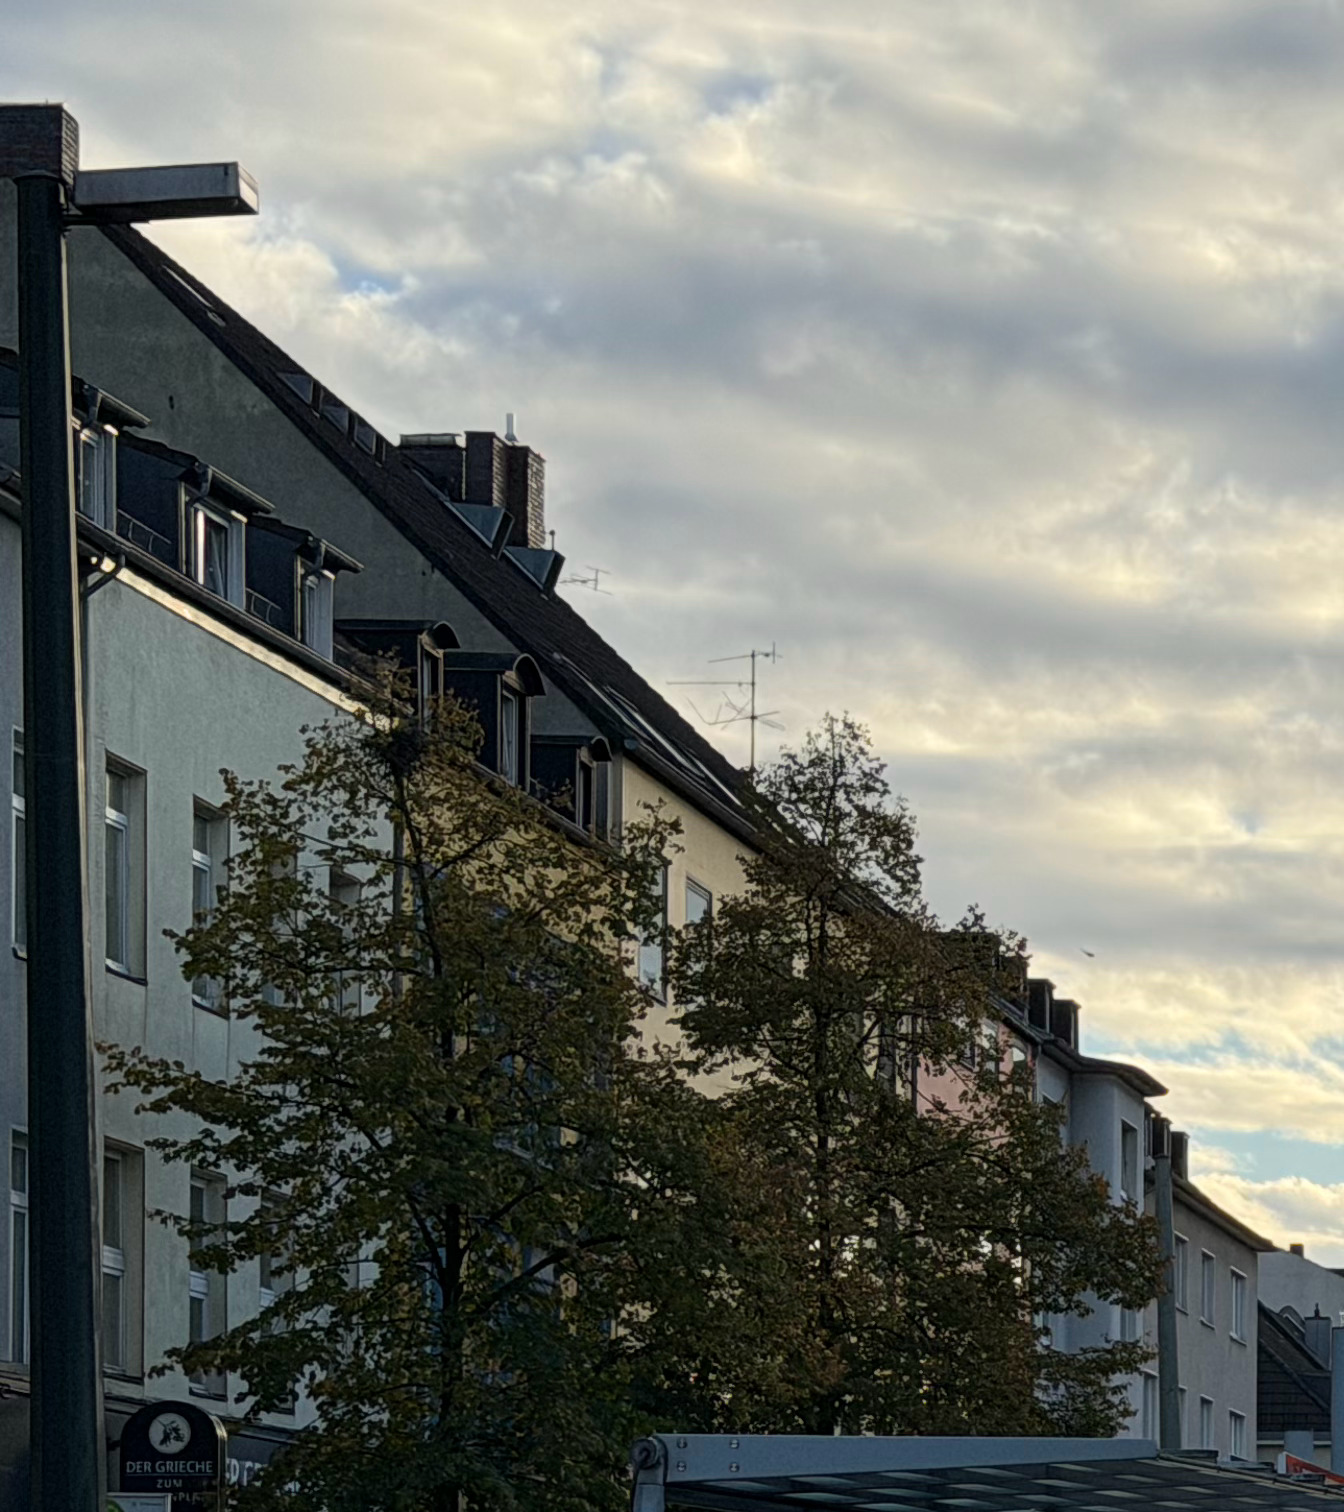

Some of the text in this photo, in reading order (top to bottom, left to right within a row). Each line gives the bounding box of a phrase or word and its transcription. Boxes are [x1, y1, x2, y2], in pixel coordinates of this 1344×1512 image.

[126, 1461, 213, 1473] DER GRIECHE
[156, 1479, 182, 1488] ZUM
